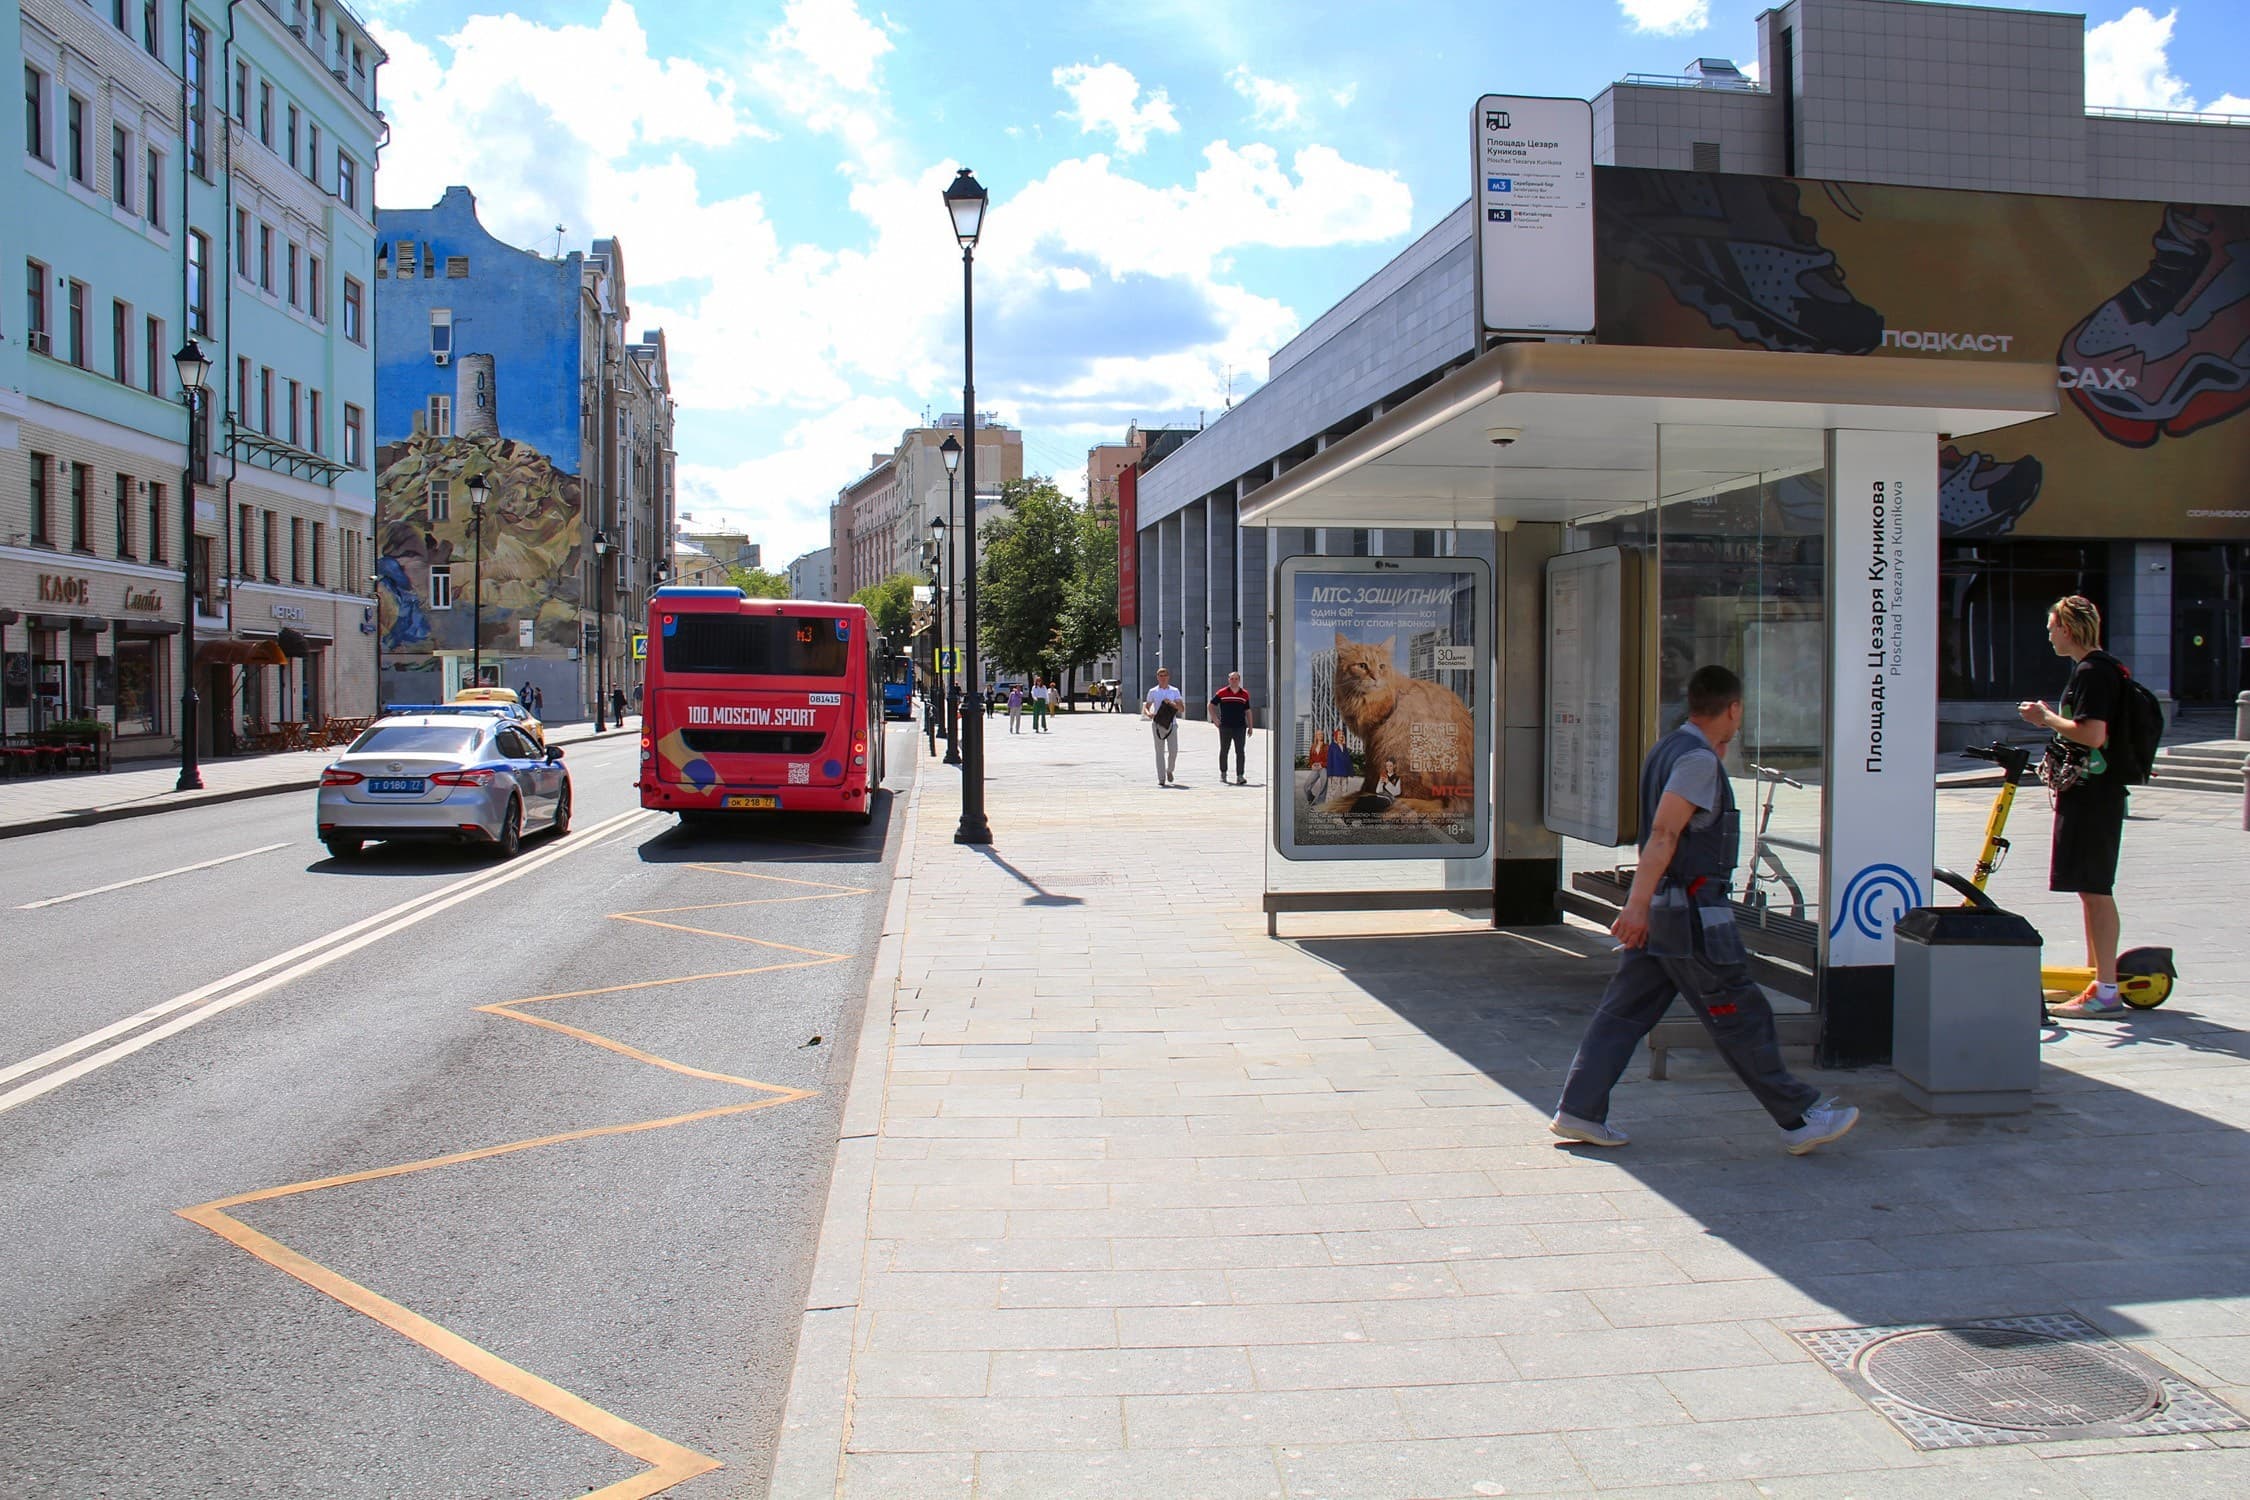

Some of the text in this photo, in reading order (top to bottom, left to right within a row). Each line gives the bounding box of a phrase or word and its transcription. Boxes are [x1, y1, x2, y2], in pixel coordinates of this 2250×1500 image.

[1487, 138, 1559, 149] Площадь Цезаря
[1487, 147, 1527, 157] Куникова
[1882, 329, 2013, 352] ПОДКАСТ
[2057, 365, 2137, 391] САХ»
[1890, 481, 1905, 677] Ploschad Tsezarya Kunikova
[39, 574, 89, 605] КАФЕ
[1312, 587, 1455, 607] МТС ЗАЩИТНИК
[1339, 607, 1354, 617] QR
[1866, 481, 1887, 773] Площадь Цезаря Куникова
[1438, 649, 1453, 661] 30
[810, 695, 840, 704] 081415
[688, 706, 816, 726] 100.MOSCOW.SPORT
[1431, 785, 1474, 796] МТС
[1447, 825, 1465, 835] 18+
